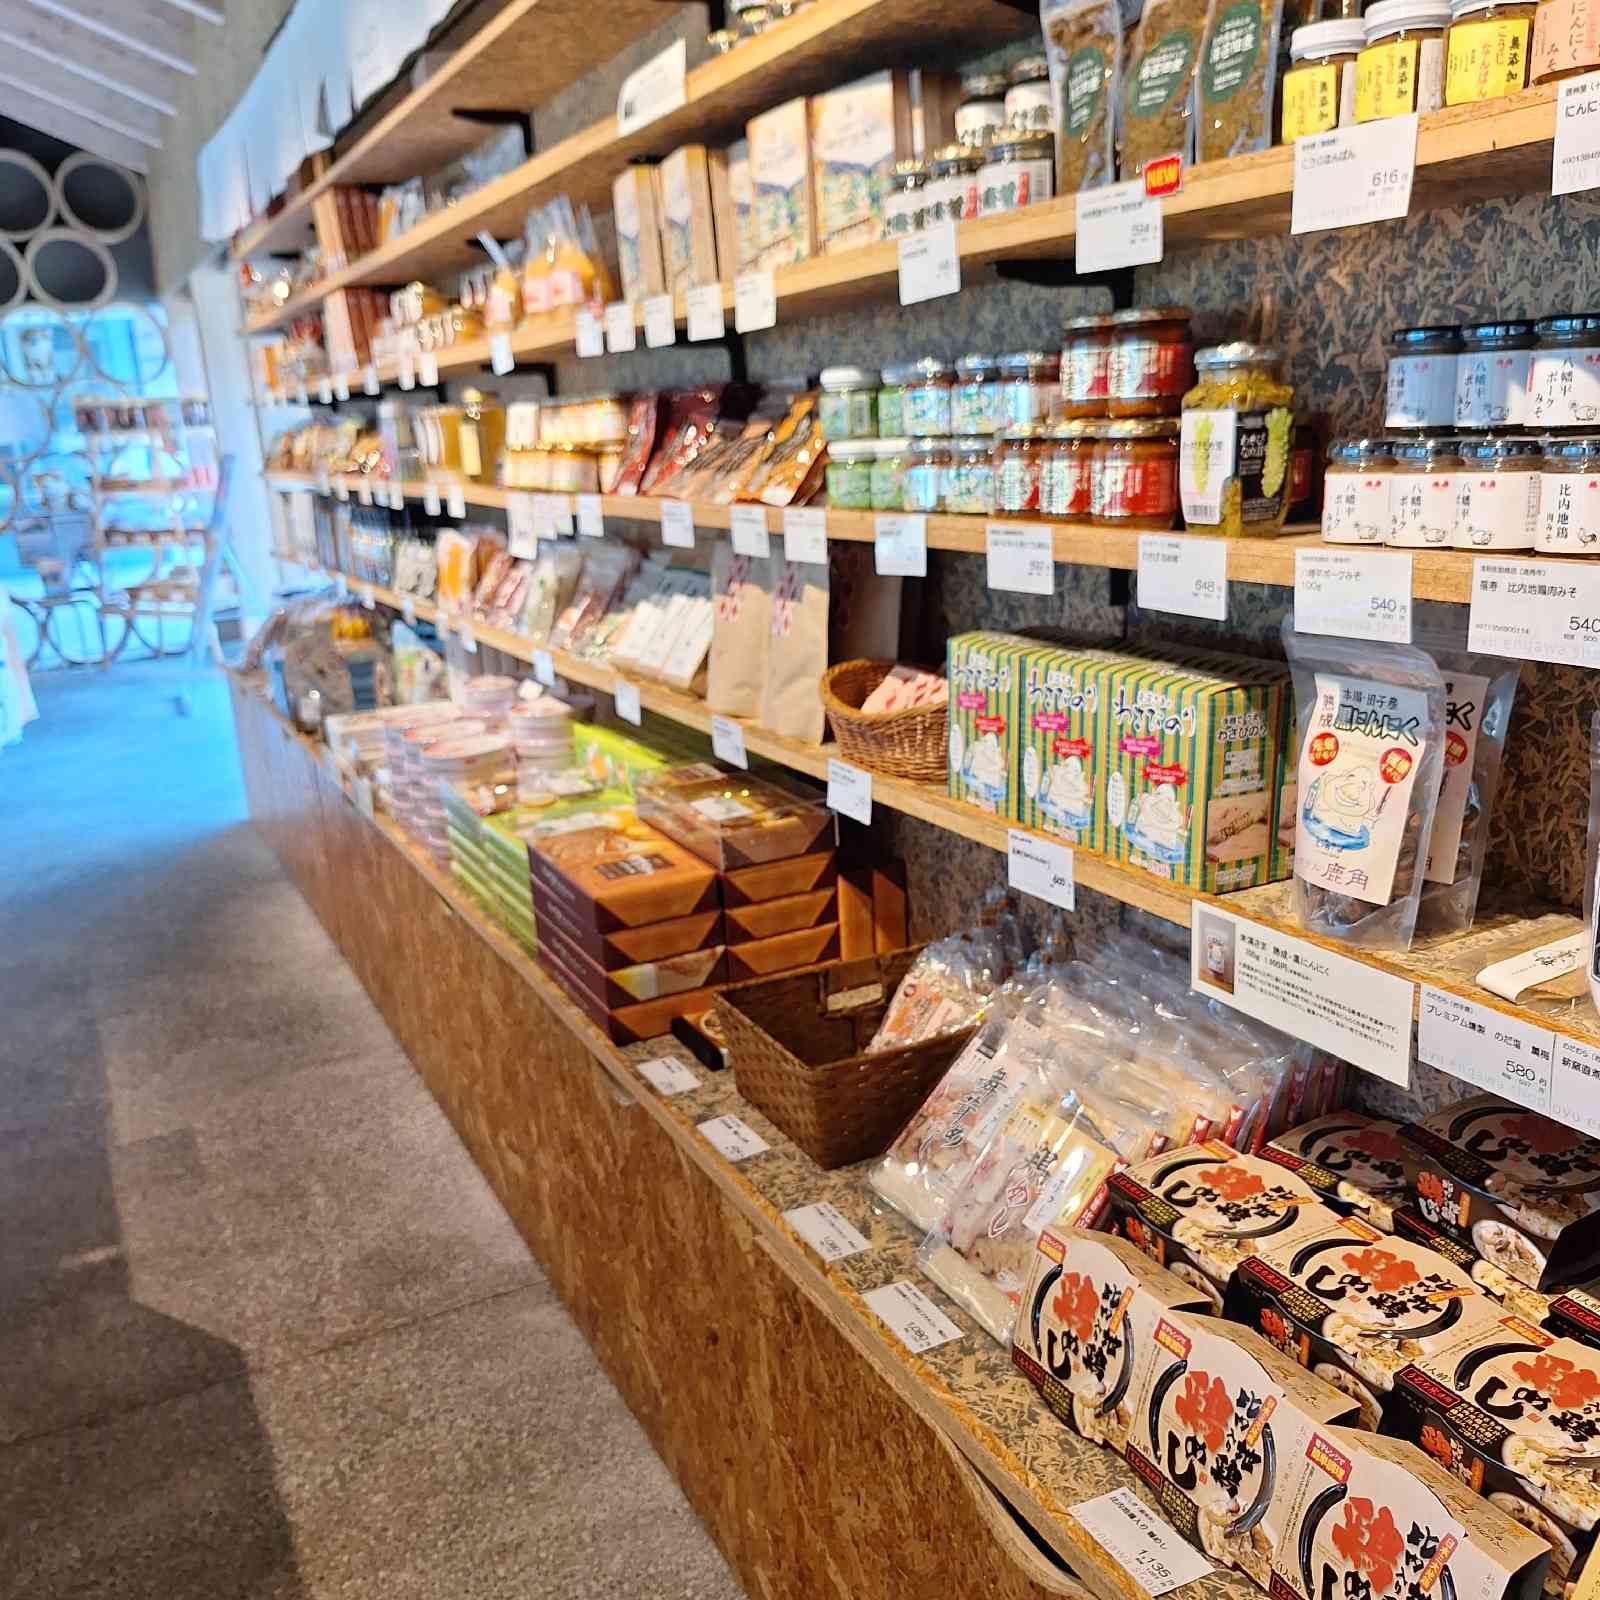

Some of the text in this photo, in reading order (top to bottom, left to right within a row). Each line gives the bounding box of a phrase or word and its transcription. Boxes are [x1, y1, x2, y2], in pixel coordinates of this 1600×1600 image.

[1565, 100, 1600, 118] にんに
[1147, 163, 1178, 190] NEW
[1372, 169, 1398, 187] 616
[1370, 597, 1397, 612] 540
[1320, 862, 1369, 891] 鹿角
[1505, 1060, 1536, 1082] 580
[1139, 1549, 1171, 1578] 1,135
